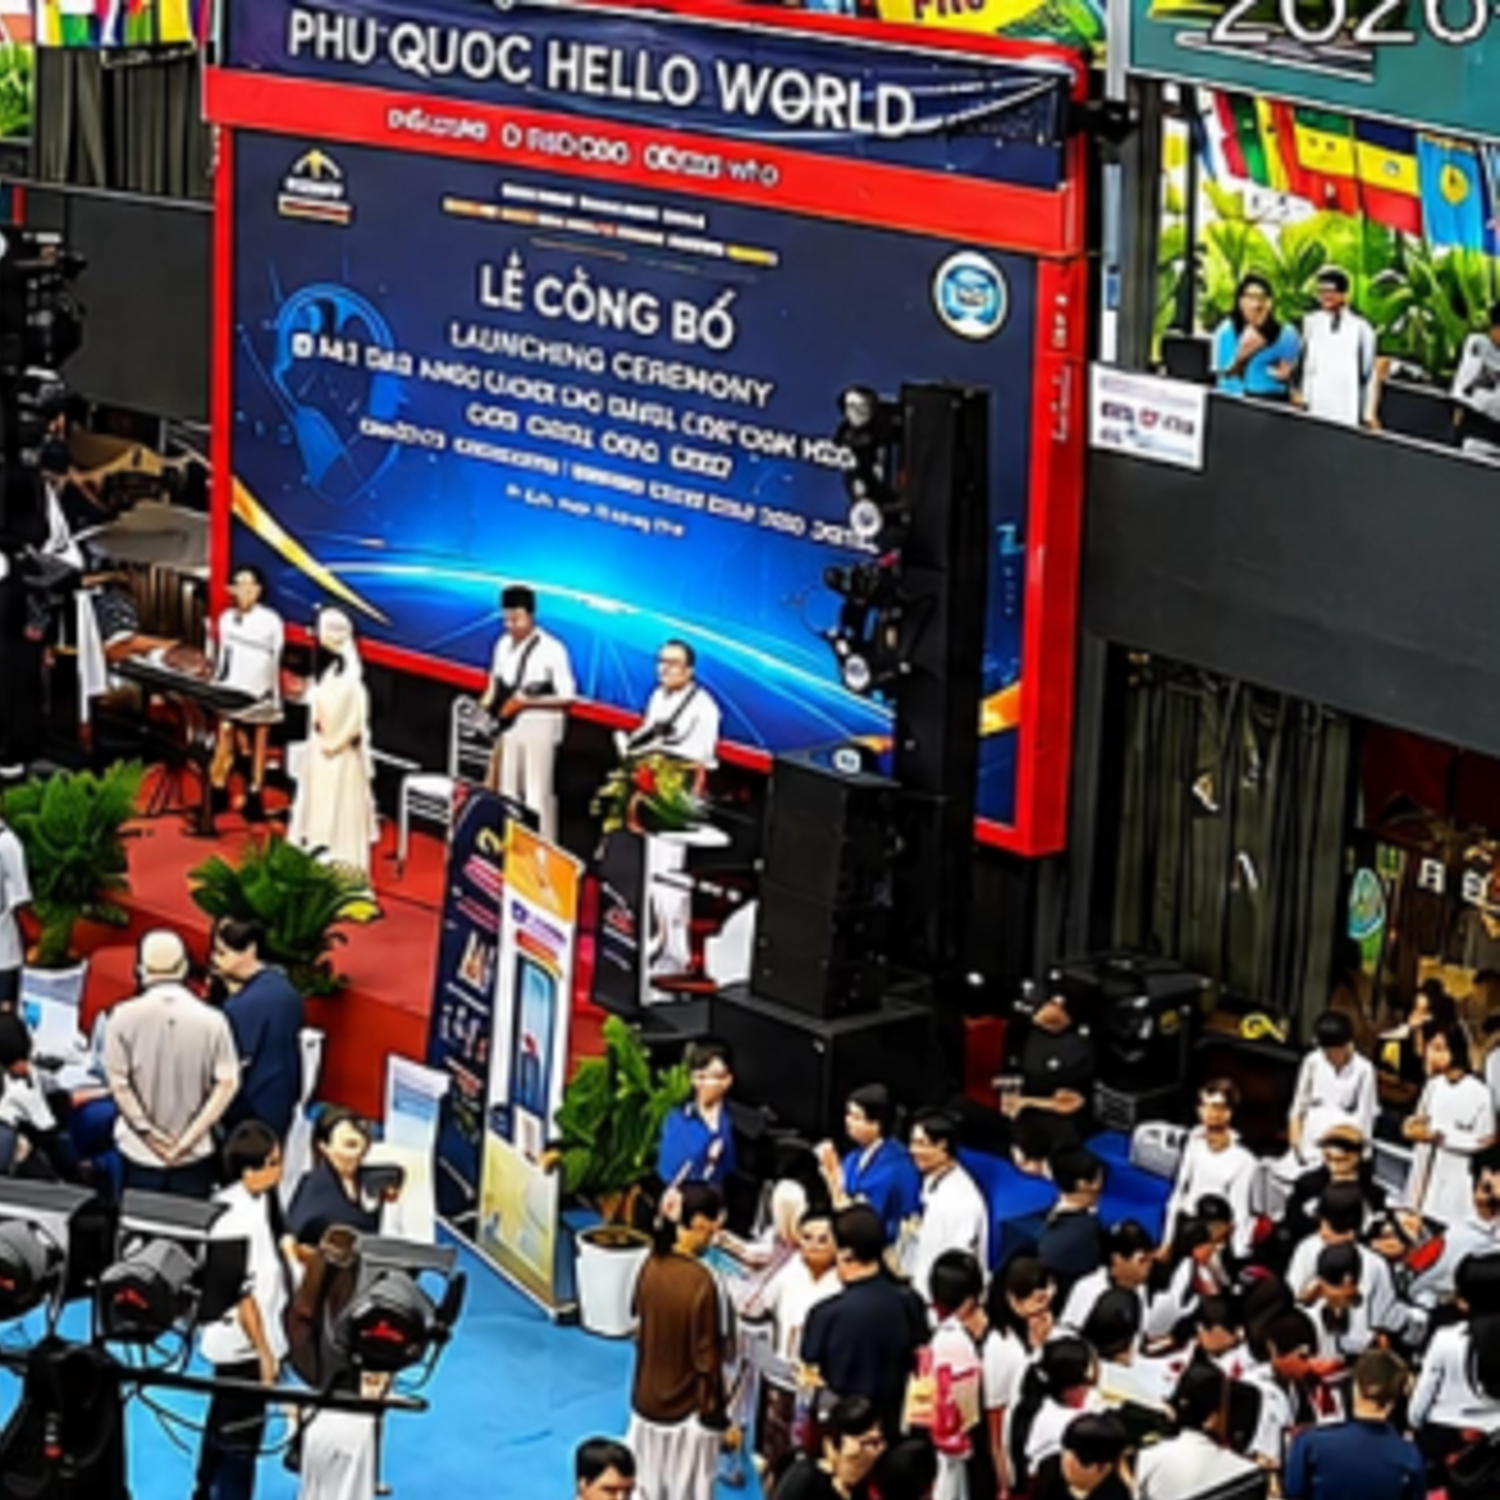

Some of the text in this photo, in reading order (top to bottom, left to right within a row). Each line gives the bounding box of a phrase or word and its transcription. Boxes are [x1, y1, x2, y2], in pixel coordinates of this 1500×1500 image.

[547, 39, 699, 106] HELLO
[716, 59, 917, 138] WORLD
[450, 321, 606, 373] LAUNCHING
[611, 351, 774, 409] CEREMONY
